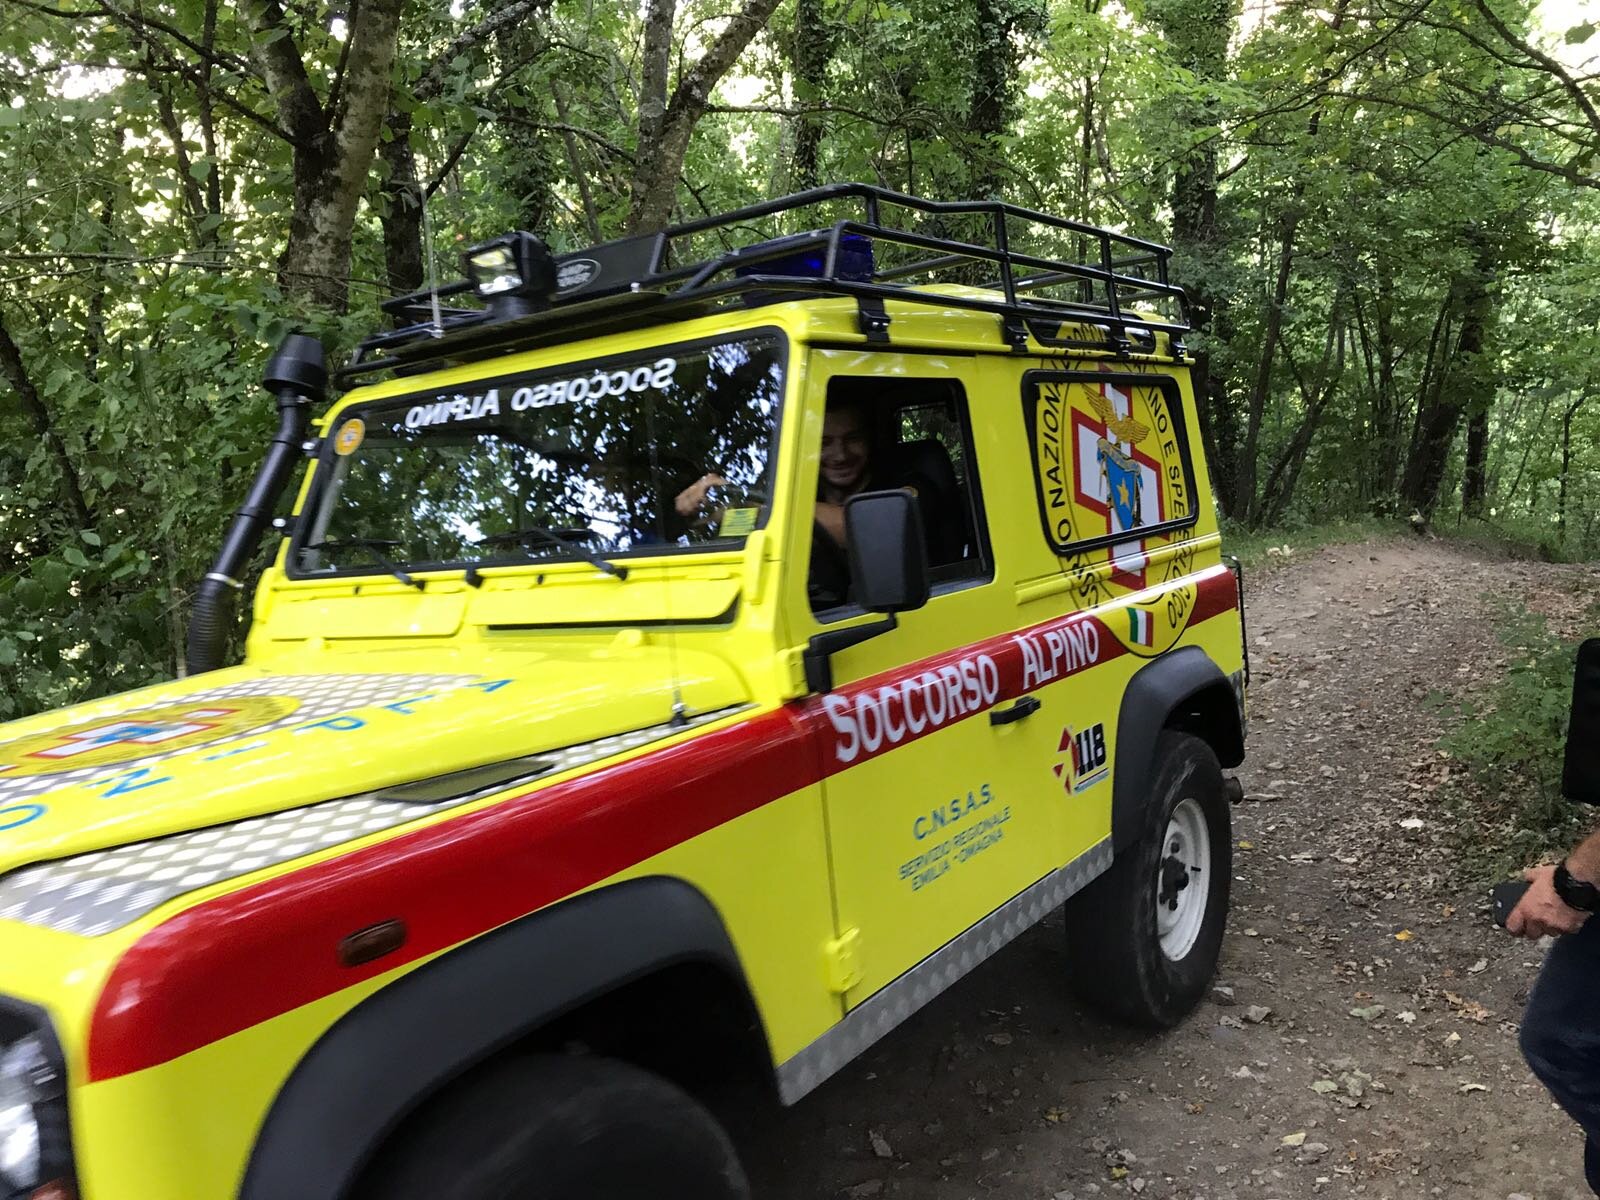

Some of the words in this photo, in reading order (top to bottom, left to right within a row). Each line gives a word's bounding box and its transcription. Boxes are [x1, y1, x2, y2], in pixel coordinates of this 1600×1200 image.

[1163, 440, 1175, 457] E
[821, 654, 1000, 763] SOCCORSO
[1014, 620, 1100, 690] ALPINO
[1075, 722, 1107, 777] 118
[952, 806, 1012, 848] REGIONALE
[911, 859, 951, 892] EMILIA
